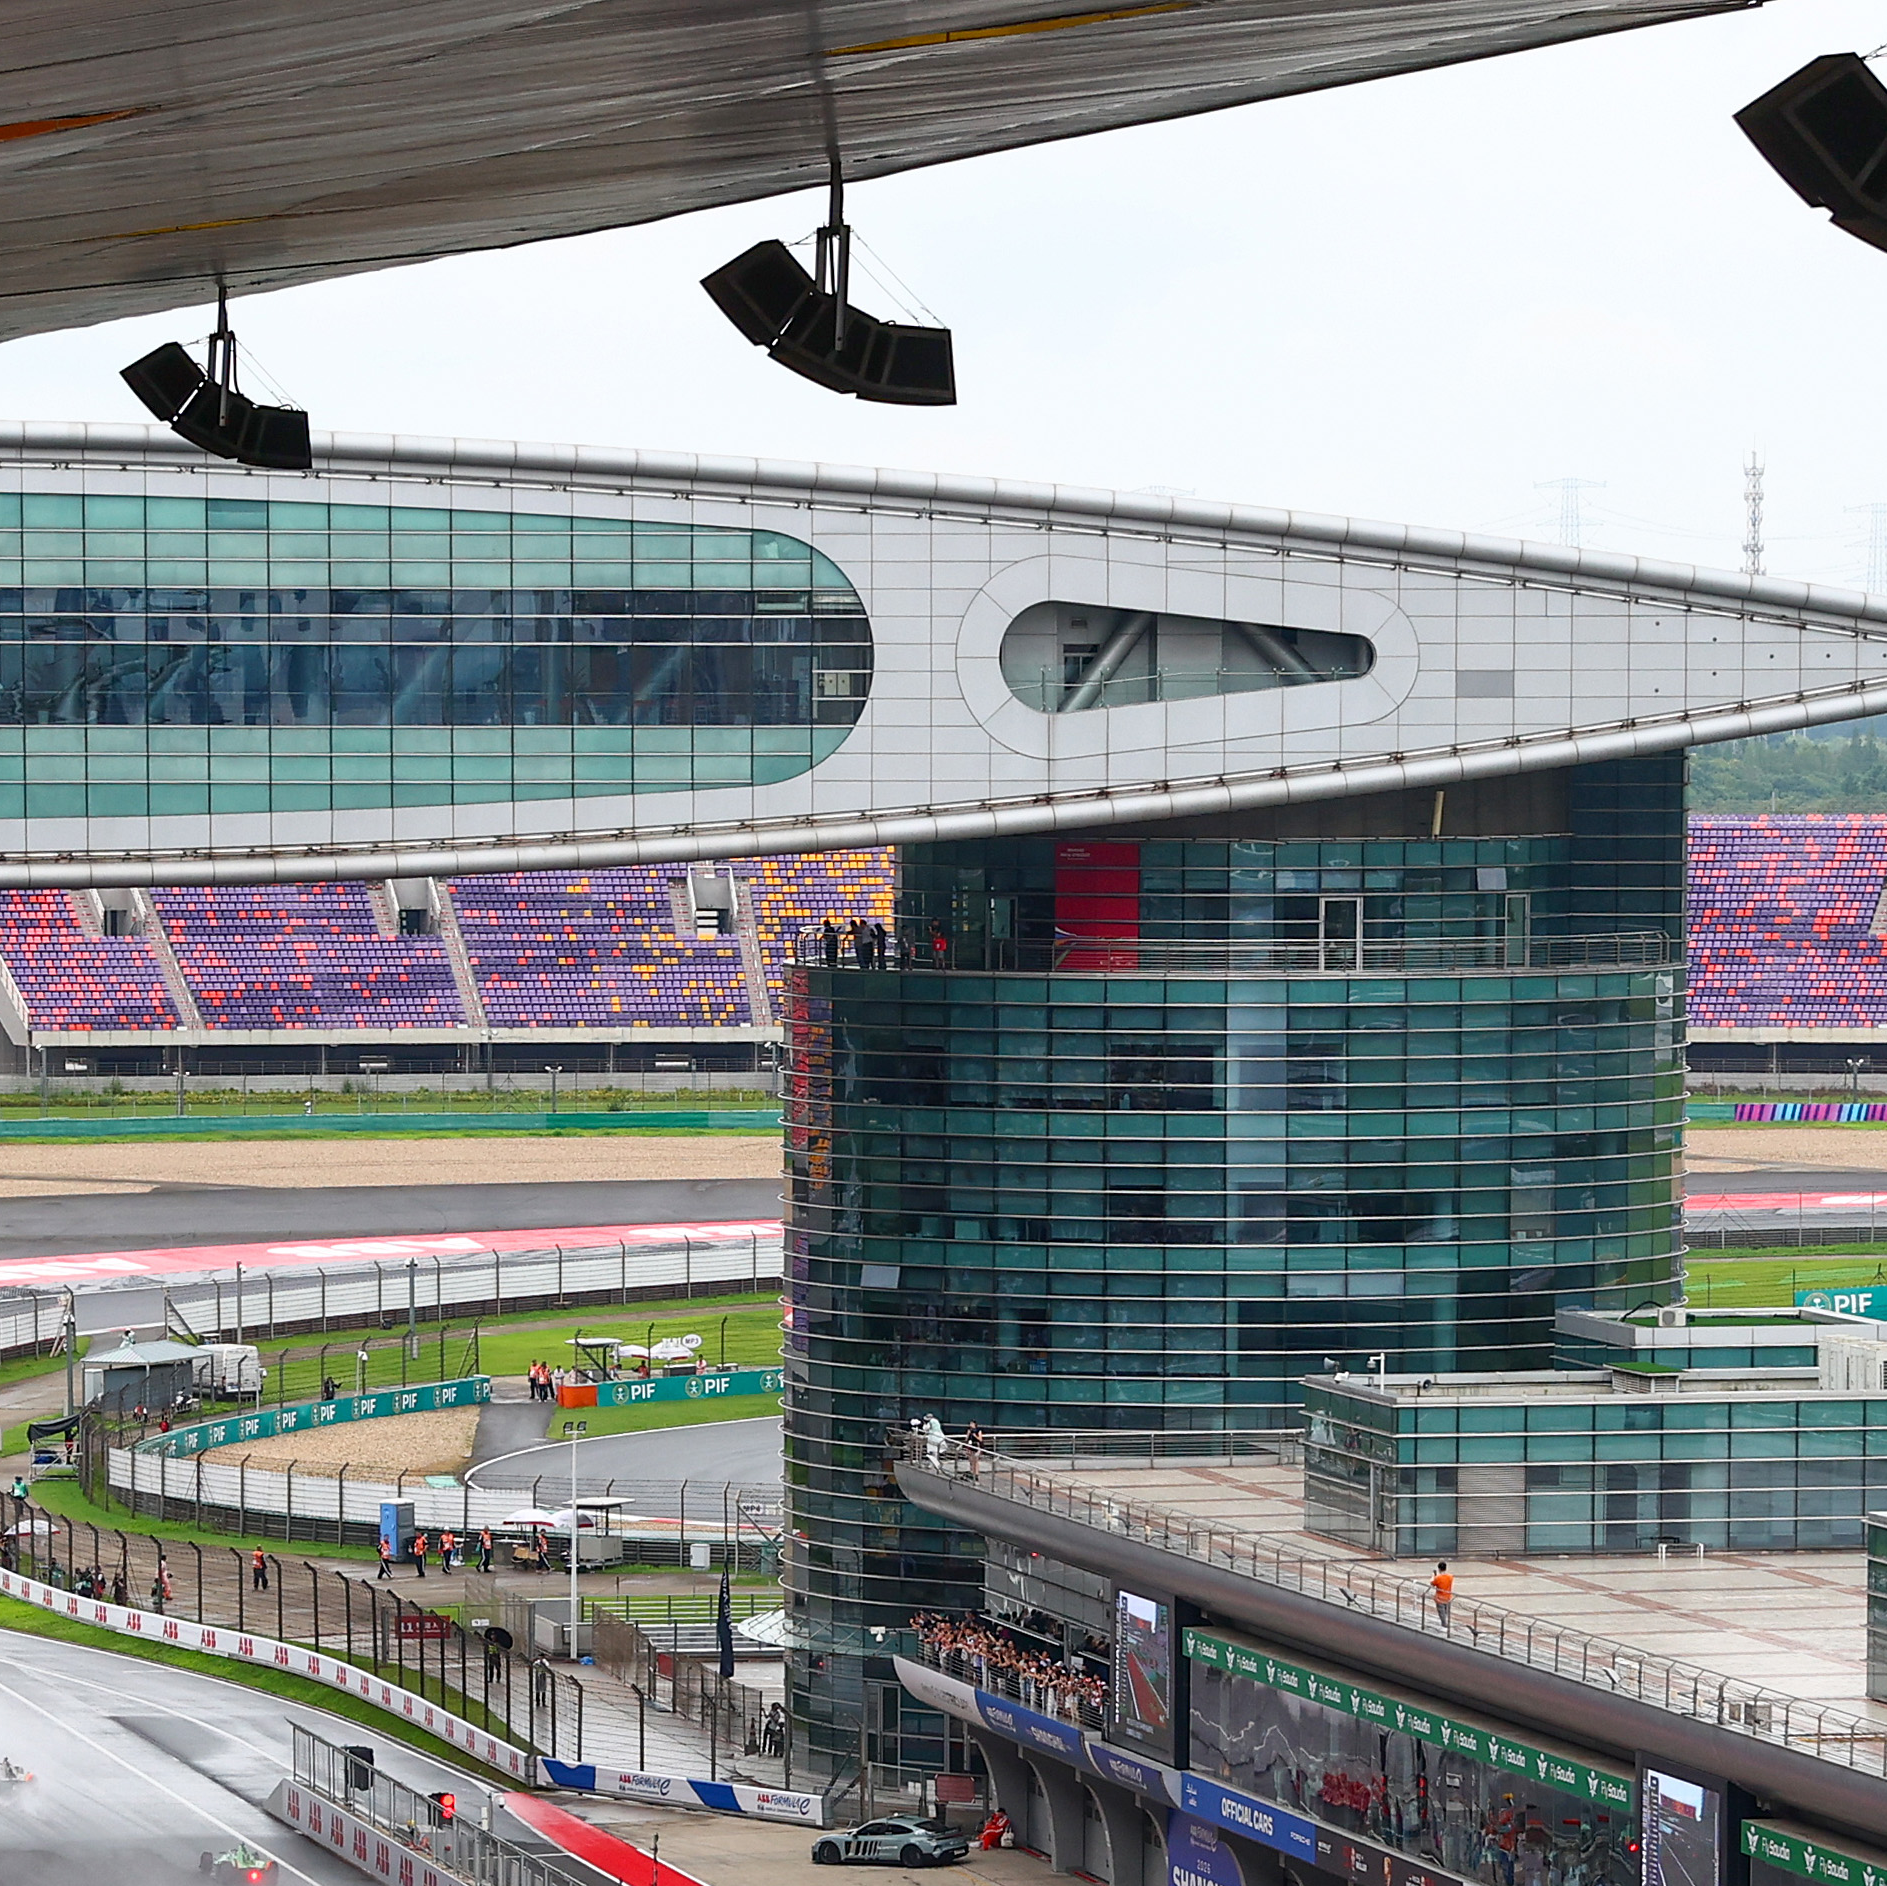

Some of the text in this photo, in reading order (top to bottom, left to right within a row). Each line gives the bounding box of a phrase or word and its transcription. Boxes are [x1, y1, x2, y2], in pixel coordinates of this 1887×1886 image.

[1834, 1293, 1873, 1312] PIF
[632, 1383, 656, 1399] PIF
[705, 1378, 730, 1394] PIF
[402, 1393, 418, 1409] PIF
[442, 1388, 457, 1404] PIF
[320, 1405, 336, 1422] PIF
[360, 1399, 377, 1415] PIF
[241, 1419, 260, 1436] PIF
[283, 1412, 297, 1429] PIF
[126, 1614, 142, 1631] ABB
[201, 1632, 217, 1648] ABB
[275, 1651, 289, 1666] ABB
[618, 1773, 632, 1785] ABB
[1222, 1797, 1274, 1836] OFFICIAL CARS
